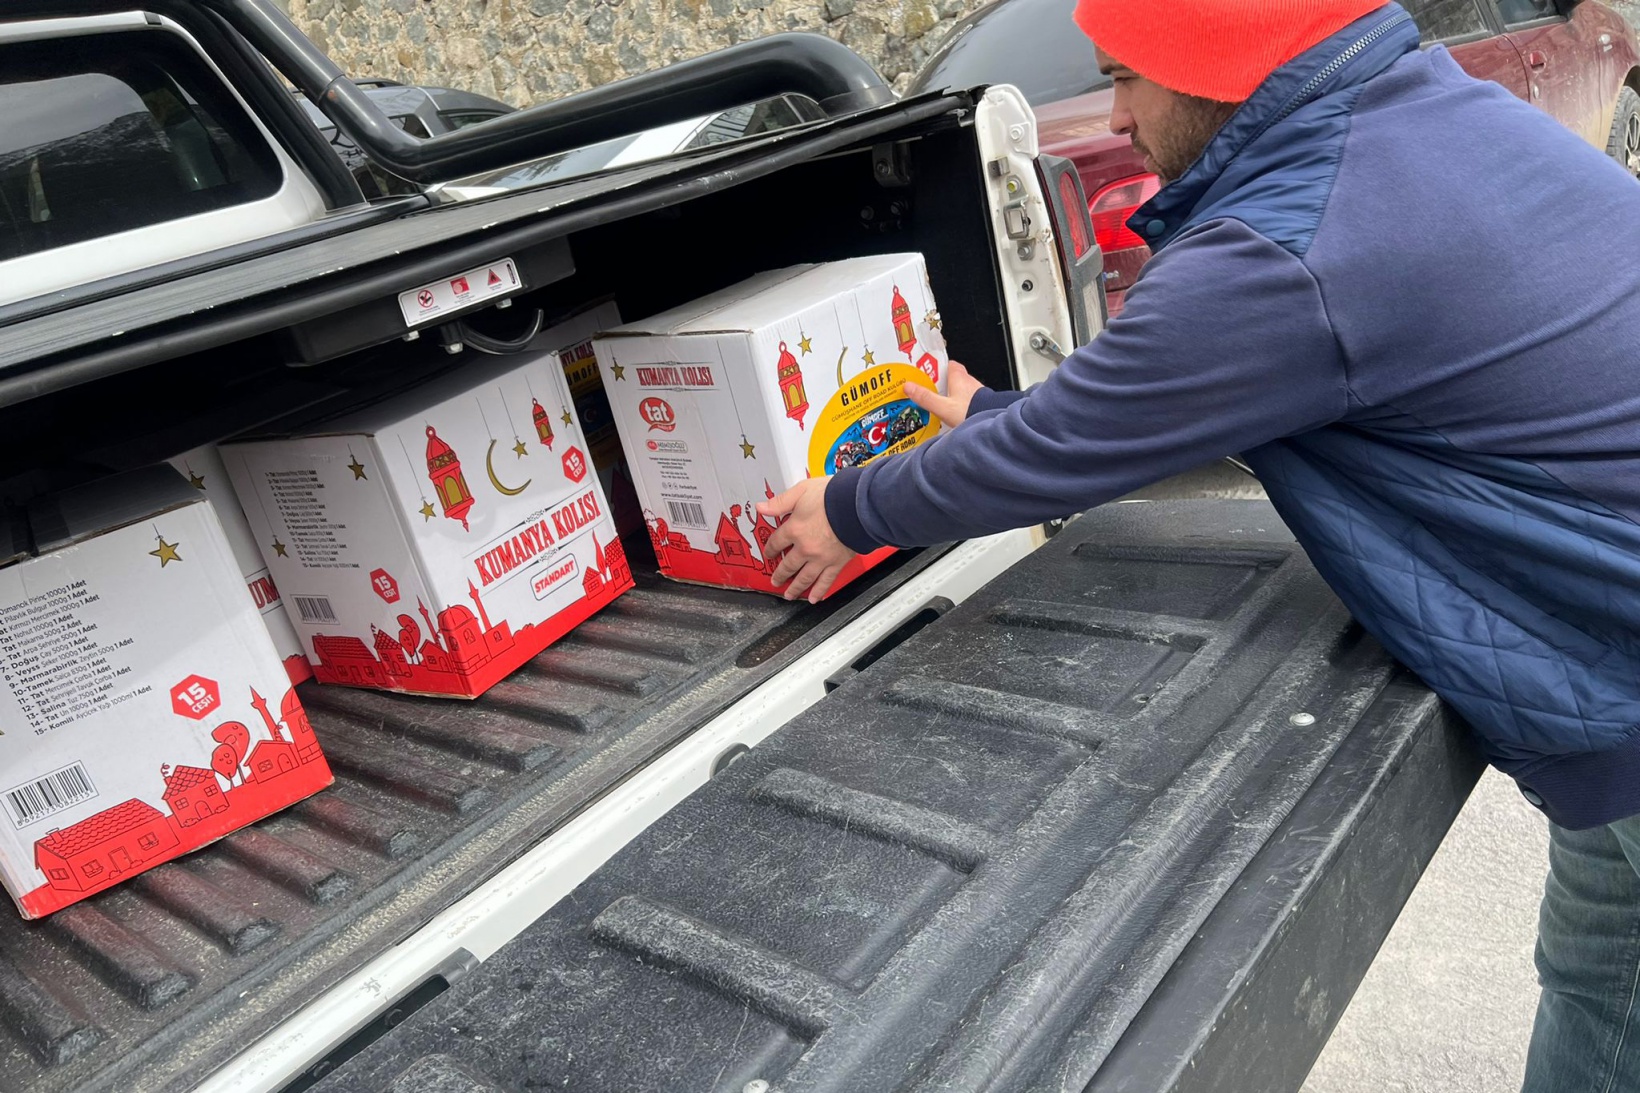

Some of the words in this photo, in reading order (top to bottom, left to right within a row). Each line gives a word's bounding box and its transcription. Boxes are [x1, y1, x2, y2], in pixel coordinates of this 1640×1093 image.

[636, 367, 682, 386] KUMANYA
[841, 369, 891, 407] GÜMOFF
[645, 401, 671, 422] tat
[862, 397, 873, 405] OFF
[873, 388, 888, 399] ROAD
[900, 436, 916, 452] ROAD
[565, 452, 581, 472] 15
[474, 519, 555, 587] KUMANYA
[46, 587, 67, 599] 1000g
[71, 579, 87, 590] Adet
[374, 575, 392, 591] 15
[535, 560, 574, 593] STANDART
[27, 604, 48, 616] Bulgur
[47, 597, 68, 608] 1000g
[72, 589, 88, 599] Adet
[59, 601, 80, 612] 1000g
[84, 594, 100, 605] Adet
[0, 635, 13, 645] Tat
[13, 628, 34, 640] Nohut
[33, 621, 54, 632] 1000g
[58, 613, 74, 623] Adet
[2, 644, 18, 653] Tat
[18, 634, 44, 647] Makarna
[44, 627, 61, 638] 500g
[67, 620, 82, 630] Adet
[7, 652, 22, 661] Tat
[23, 646, 38, 656] Arpa
[61, 631, 78, 641] 500g
[82, 623, 98, 633] Adet
[11, 655, 39, 669] Doğuş
[52, 643, 69, 654] 500g
[73, 636, 89, 646] Adet
[15, 664, 40, 676] Veyss
[58, 650, 79, 661] 1000g
[83, 642, 99, 652] Adet
[20, 659, 79, 685] Marmarabirlik
[79, 652, 99, 663] Zeytin
[98, 645, 115, 656] 500g
[119, 637, 134, 648] Adet
[91, 657, 107, 668] Adet
[17, 697, 29, 705] 11-
[30, 691, 45, 700] Tat
[96, 665, 112, 675] Adet
[22, 705, 35, 713] 12-
[36, 698, 50, 707] Tat
[116, 666, 132, 676] Adet
[40, 701, 66, 715] Salina
[78, 690, 95, 700] 750g
[98, 682, 114, 693] Adet
[177, 682, 207, 706] 15
[30, 720, 43, 728] 14-
[45, 713, 59, 722] Tat
[60, 709, 70, 717] Un
[69, 702, 89, 712] 1000g
[93, 694, 108, 704] Adet
[34, 728, 47, 736] 15-
[49, 716, 75, 730] Komili
[110, 692, 133, 705] 1000ml
[137, 685, 152, 695] Adet
